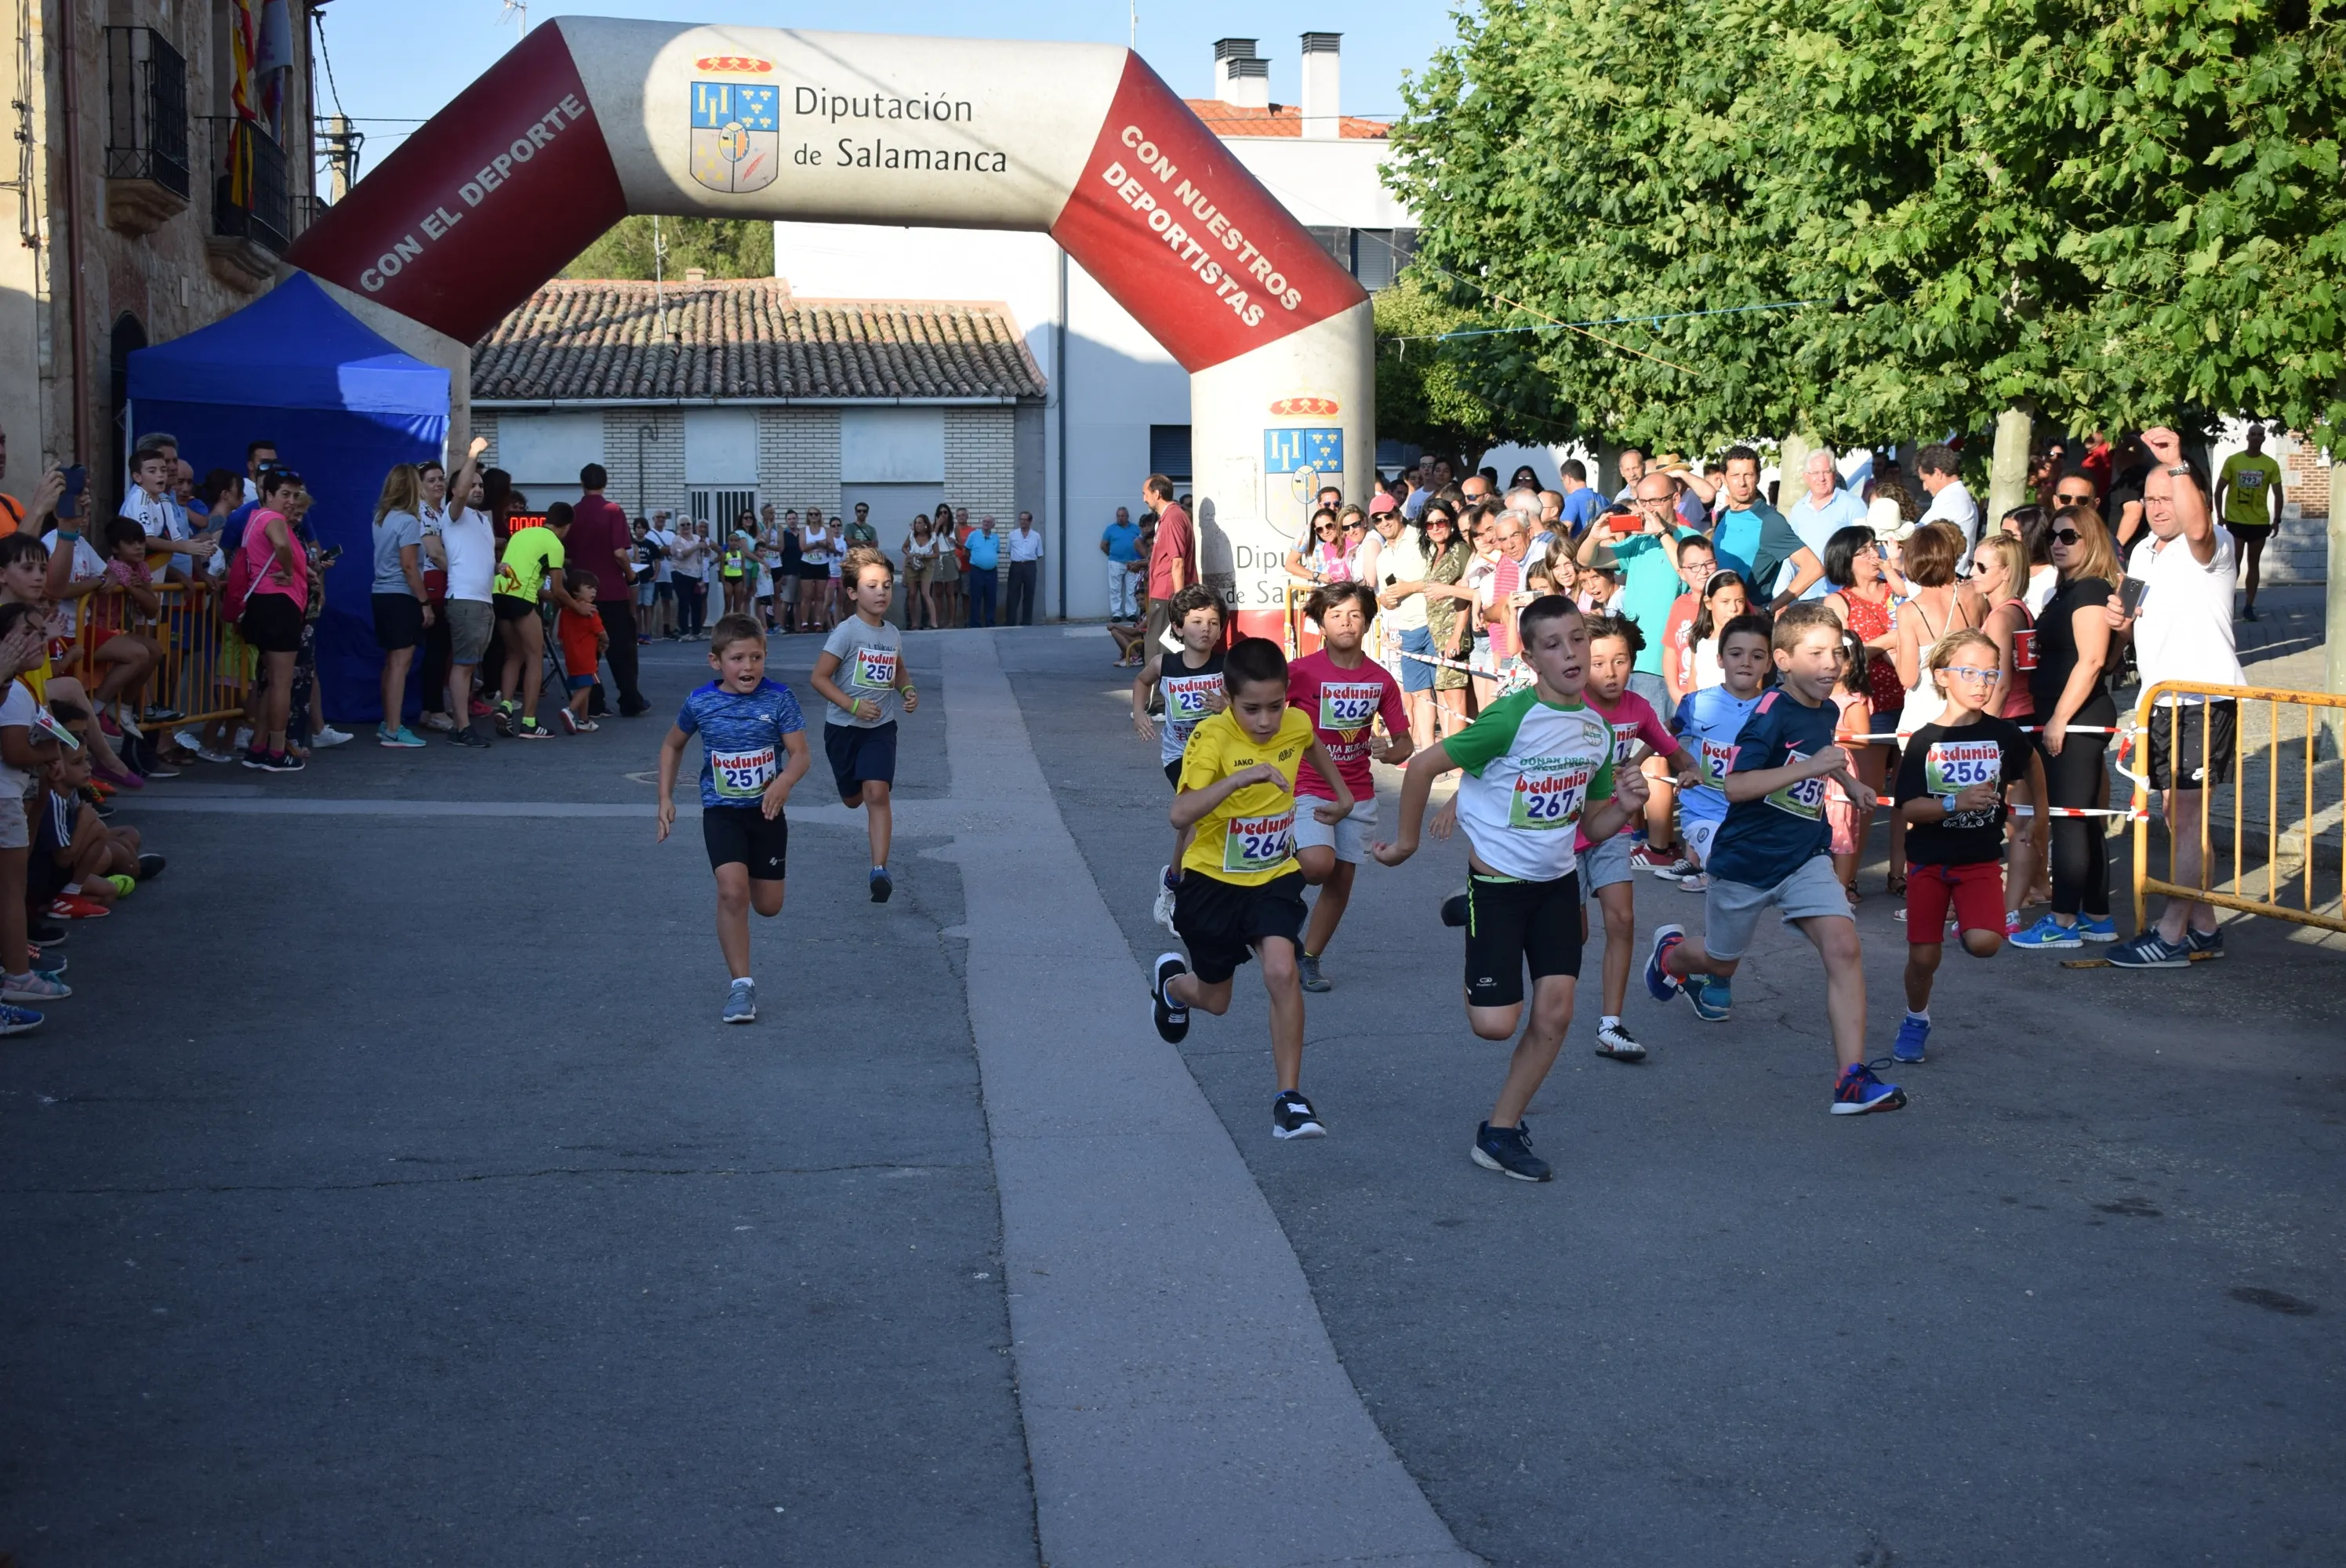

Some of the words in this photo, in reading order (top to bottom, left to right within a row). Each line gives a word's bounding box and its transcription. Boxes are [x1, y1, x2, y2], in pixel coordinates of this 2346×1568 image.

[795, 86, 972, 124] Diputación
[794, 143, 822, 166] de
[837, 138, 1007, 172] Salamanca
[361, 234, 424, 292] CON
[419, 206, 463, 241] EL
[458, 93, 586, 207] DEPORTE
[1121, 125, 1178, 183] CON
[1173, 179, 1302, 310] NUESTROS
[1102, 161, 1265, 327] DEPORTISTAS
[1226, 589, 1245, 604] de
[865, 663, 894, 681] 250
[1168, 677, 1223, 693] bedunia
[1323, 686, 1381, 699] bedunia
[1179, 692, 1204, 710] 25
[1333, 700, 1371, 719] 262
[713, 751, 775, 770] bedunia
[1233, 758, 1254, 767] JAKO
[1928, 746, 1999, 762] bedunia
[724, 767, 764, 787] 251
[1514, 770, 1588, 794] bedunia
[1941, 761, 1988, 783] 256
[1786, 779, 1825, 805] 259
[1527, 789, 1575, 818] 267
[1229, 810, 1295, 836] bedunia
[1242, 830, 1288, 858] 264
